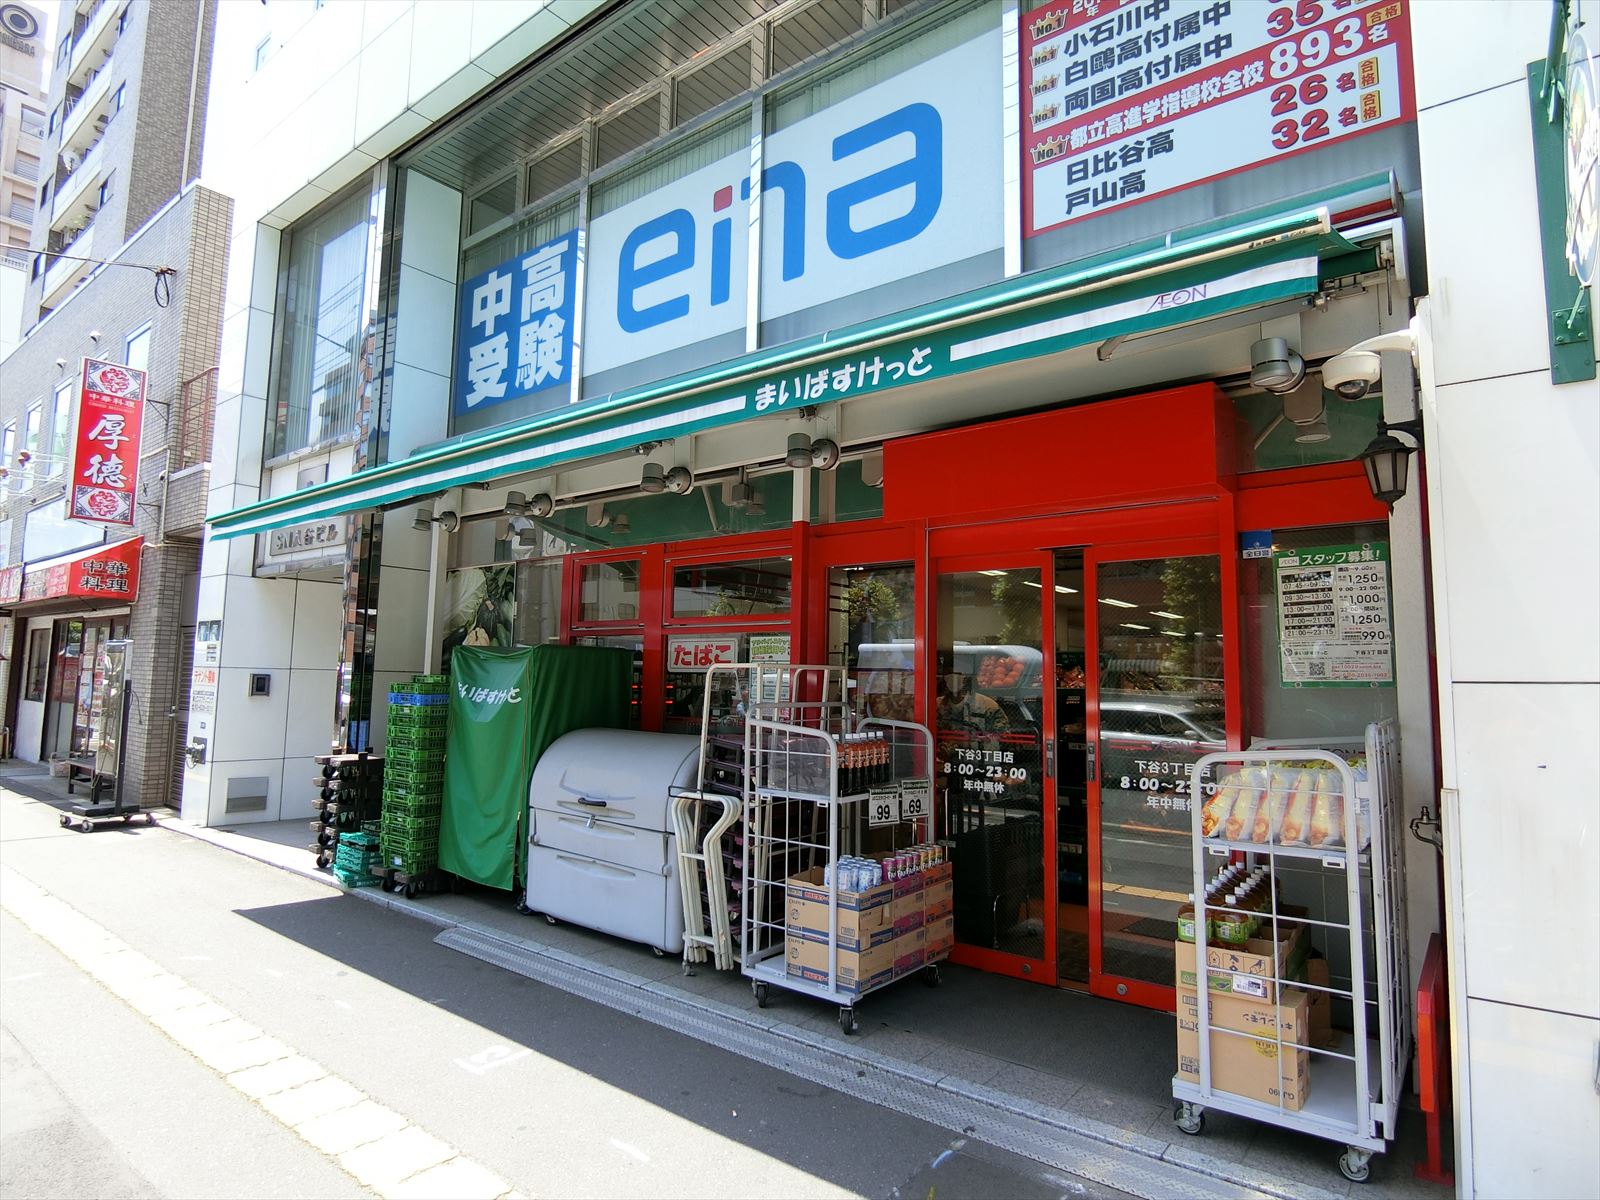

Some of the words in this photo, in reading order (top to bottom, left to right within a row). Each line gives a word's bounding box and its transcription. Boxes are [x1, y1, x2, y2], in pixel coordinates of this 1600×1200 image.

[1370, 5, 1398, 25] 合格
[1036, 17, 1063, 38] No.1
[1063, 0, 1170, 57] 小石川中
[1034, 48, 1056, 66] No.1
[1065, 33, 1233, 117] 両国高付属中
[1361, 59, 1376, 87] 合格
[1034, 78, 1057, 95] No.1
[1071, 60, 1265, 150] 都立高進学指導校全校
[1269, 17, 1364, 79] 893
[1034, 107, 1057, 124] No.1
[1363, 93, 1377, 120] 合格
[1066, 128, 1175, 186] 日比谷高
[1270, 74, 1328, 118] 26
[1036, 143, 1064, 162] No.1
[1065, 169, 1146, 216] 戸山高
[1272, 108, 1330, 150] 32
[617, 102, 943, 334] ena
[755, 346, 933, 412] まいばすけっと
[81, 559, 130, 575] 中華
[80, 577, 129, 593] 料理
[673, 643, 733, 666] たばこ
[954, 748, 1015, 764] 下谷3丁目店
[963, 779, 1005, 794] 年中無休
[876, 804, 890, 821] 99
[908, 798, 922, 815] 69
